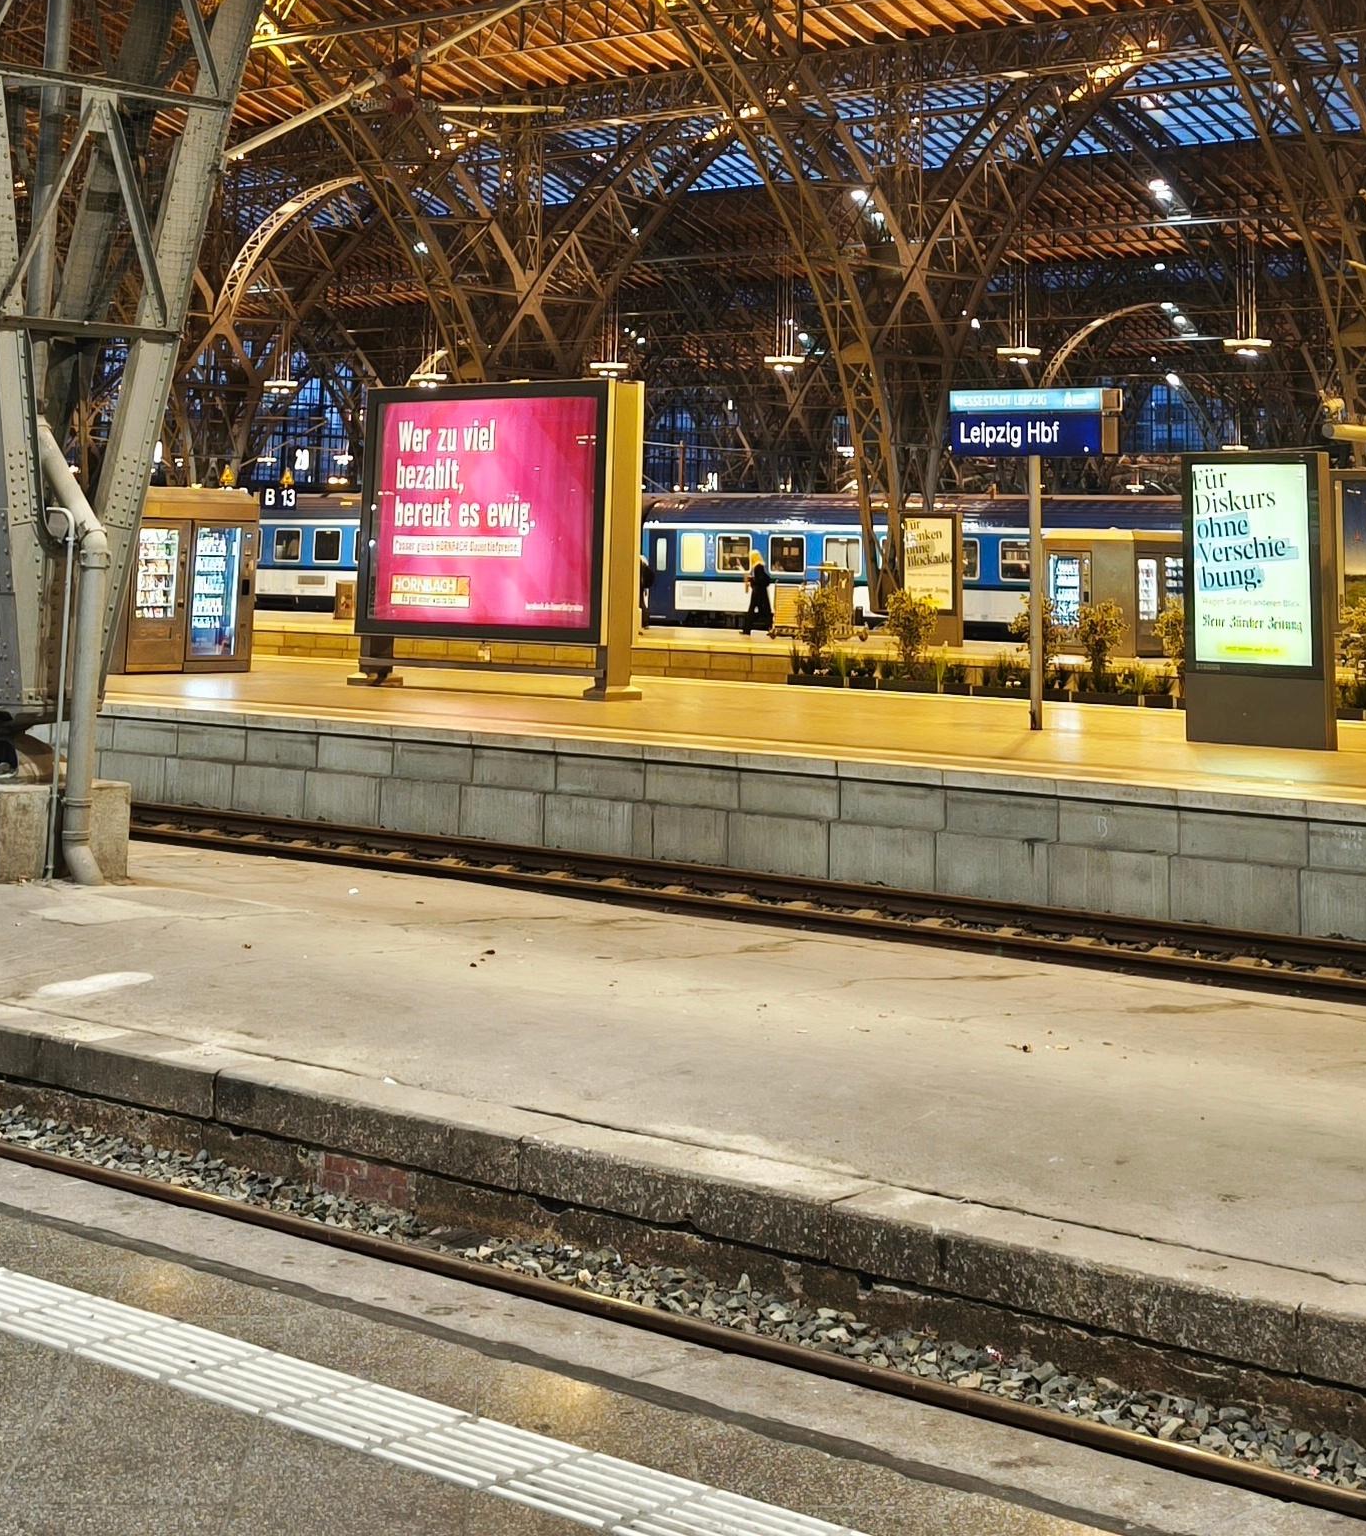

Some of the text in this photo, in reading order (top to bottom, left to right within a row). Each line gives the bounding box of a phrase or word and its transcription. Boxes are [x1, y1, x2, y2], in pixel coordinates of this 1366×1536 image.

[398, 419, 496, 452] Wer zu viel
[959, 421, 1060, 448] Leipzig Hbf
[395, 458, 464, 494] bezahlt,
[1192, 468, 1227, 491] Für
[264, 488, 296, 507] B 13
[1195, 490, 1276, 515] Diskurs
[394, 495, 536, 536] bereut es ewig.
[1197, 517, 1248, 539] ohne
[707, 534, 714, 544] 2
[1202, 566, 1262, 592] bung.
